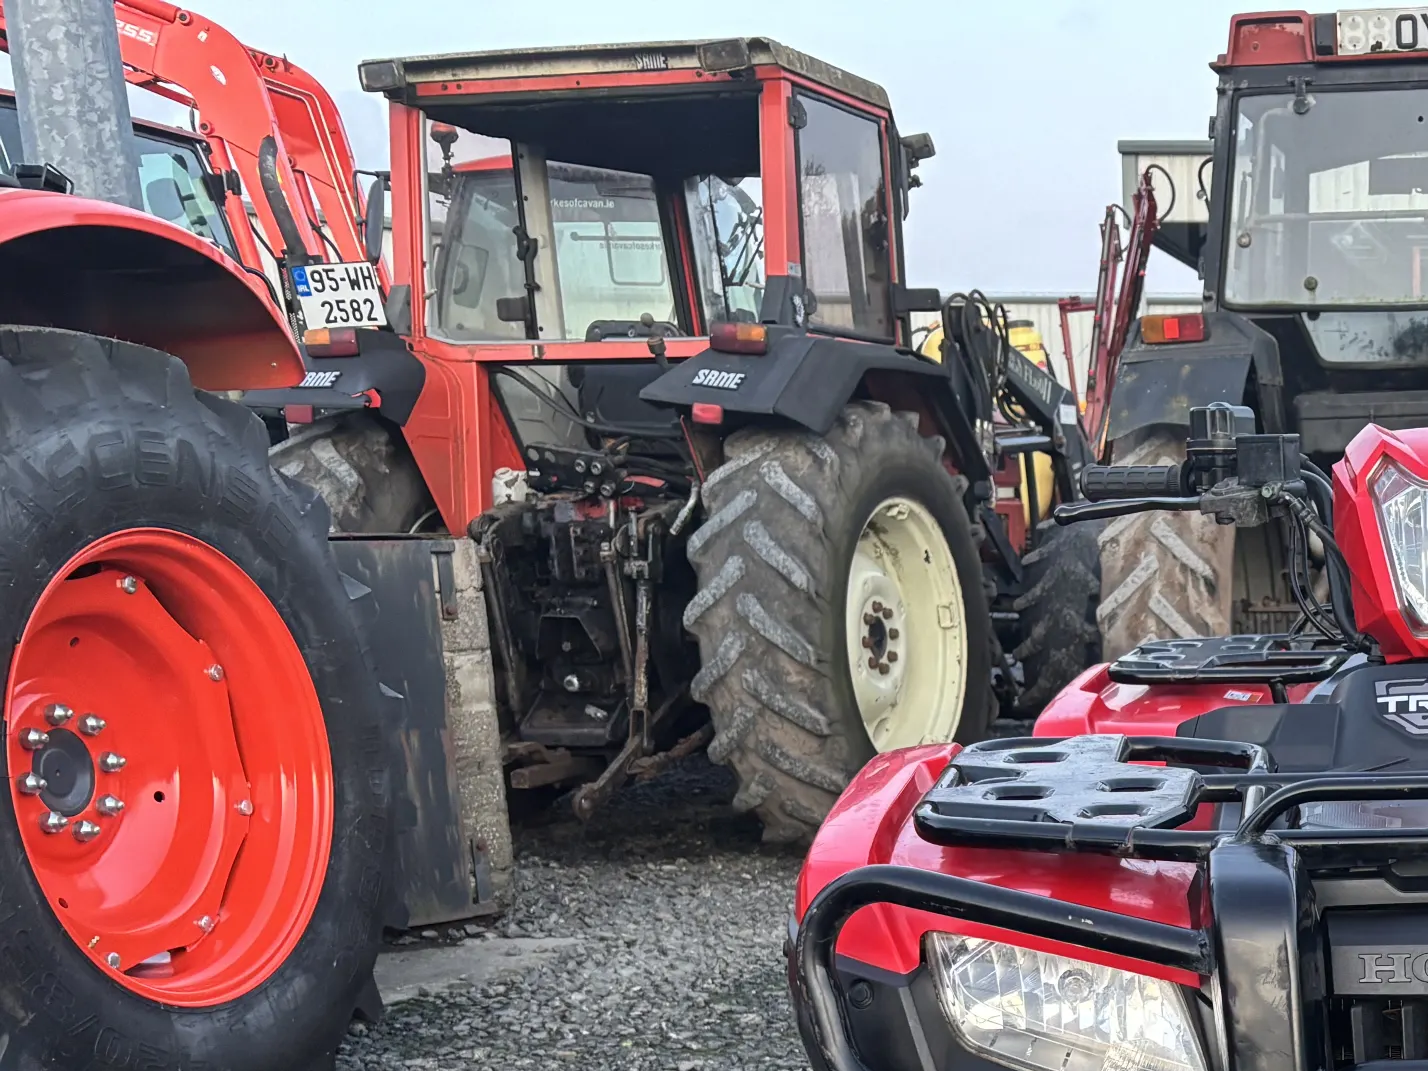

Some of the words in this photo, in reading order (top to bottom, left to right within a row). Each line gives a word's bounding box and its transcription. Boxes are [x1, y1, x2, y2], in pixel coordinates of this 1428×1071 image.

[310, 266, 375, 293] 95-WH
[320, 298, 378, 324] 2582
[299, 371, 340, 387] AME
[692, 368, 745, 389] SAME
